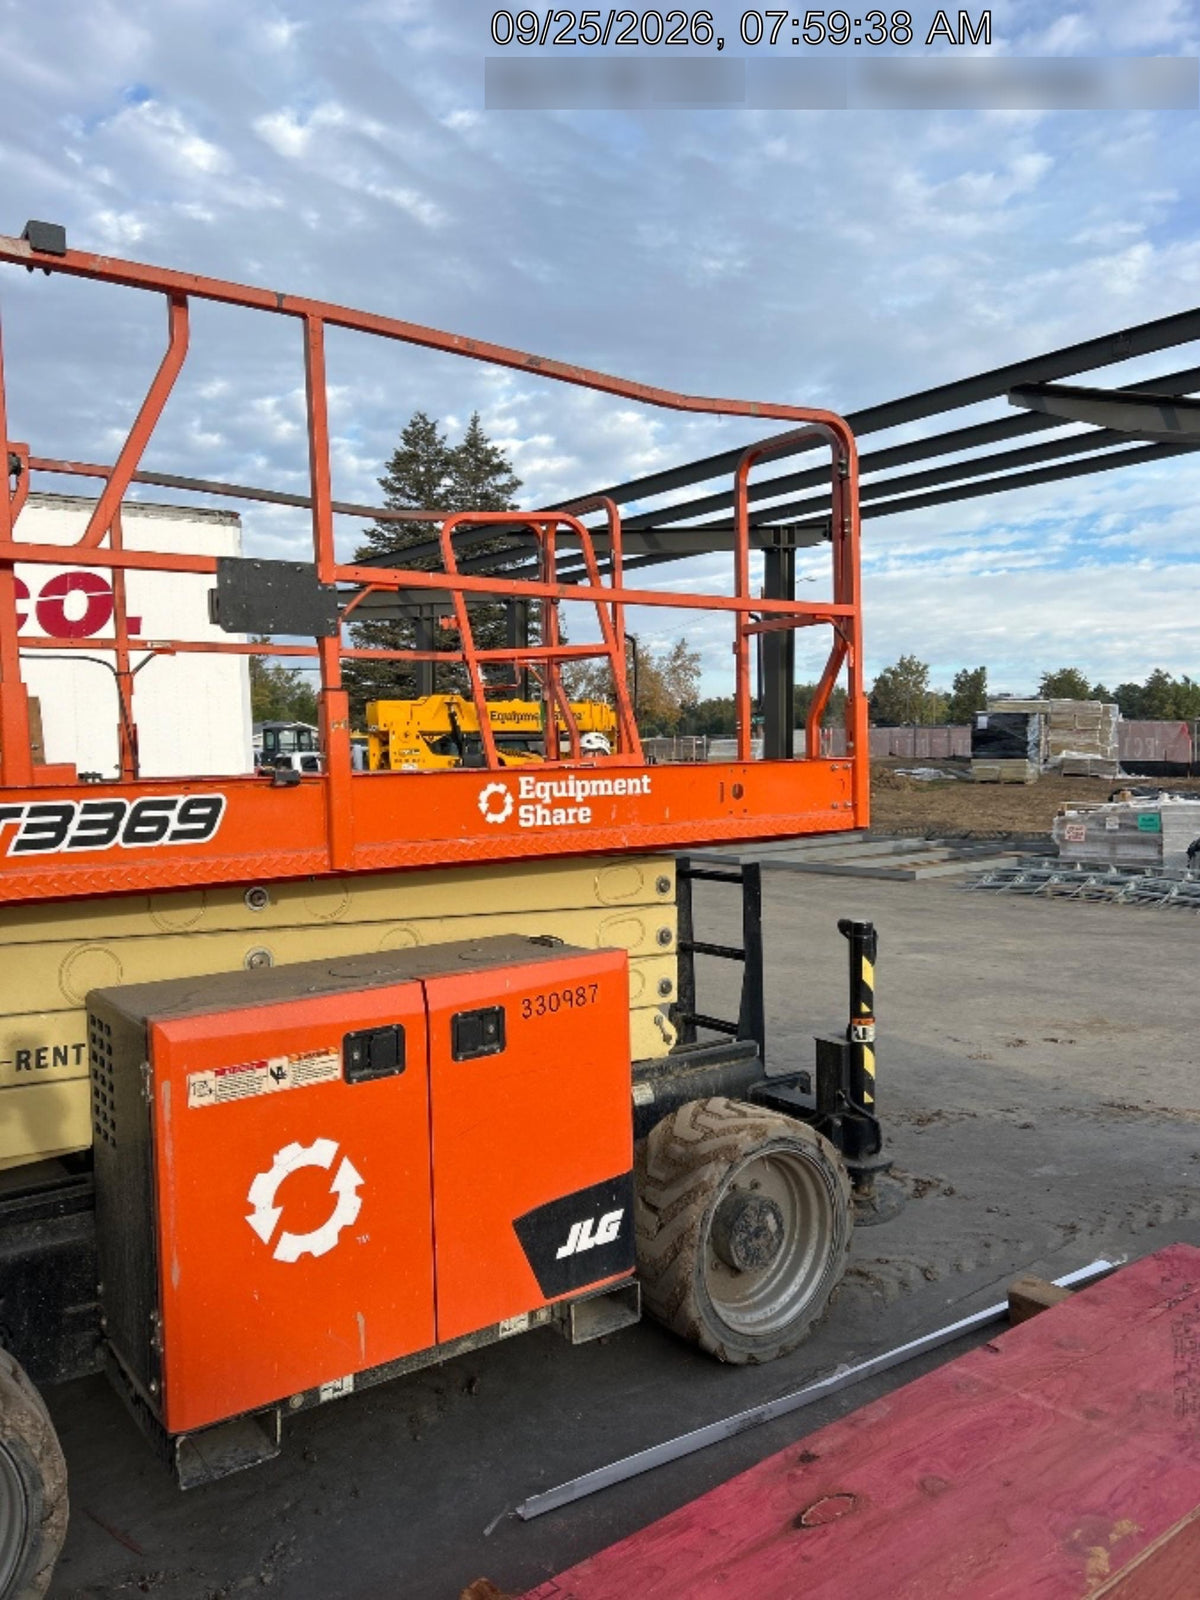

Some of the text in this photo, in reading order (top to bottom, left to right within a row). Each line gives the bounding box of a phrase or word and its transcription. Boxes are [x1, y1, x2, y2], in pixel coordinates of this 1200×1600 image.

[519, 775, 652, 804] Equipment
[518, 804, 592, 828] Share
[521, 983, 599, 1020] 330987
[555, 1208, 625, 1260] JLG
